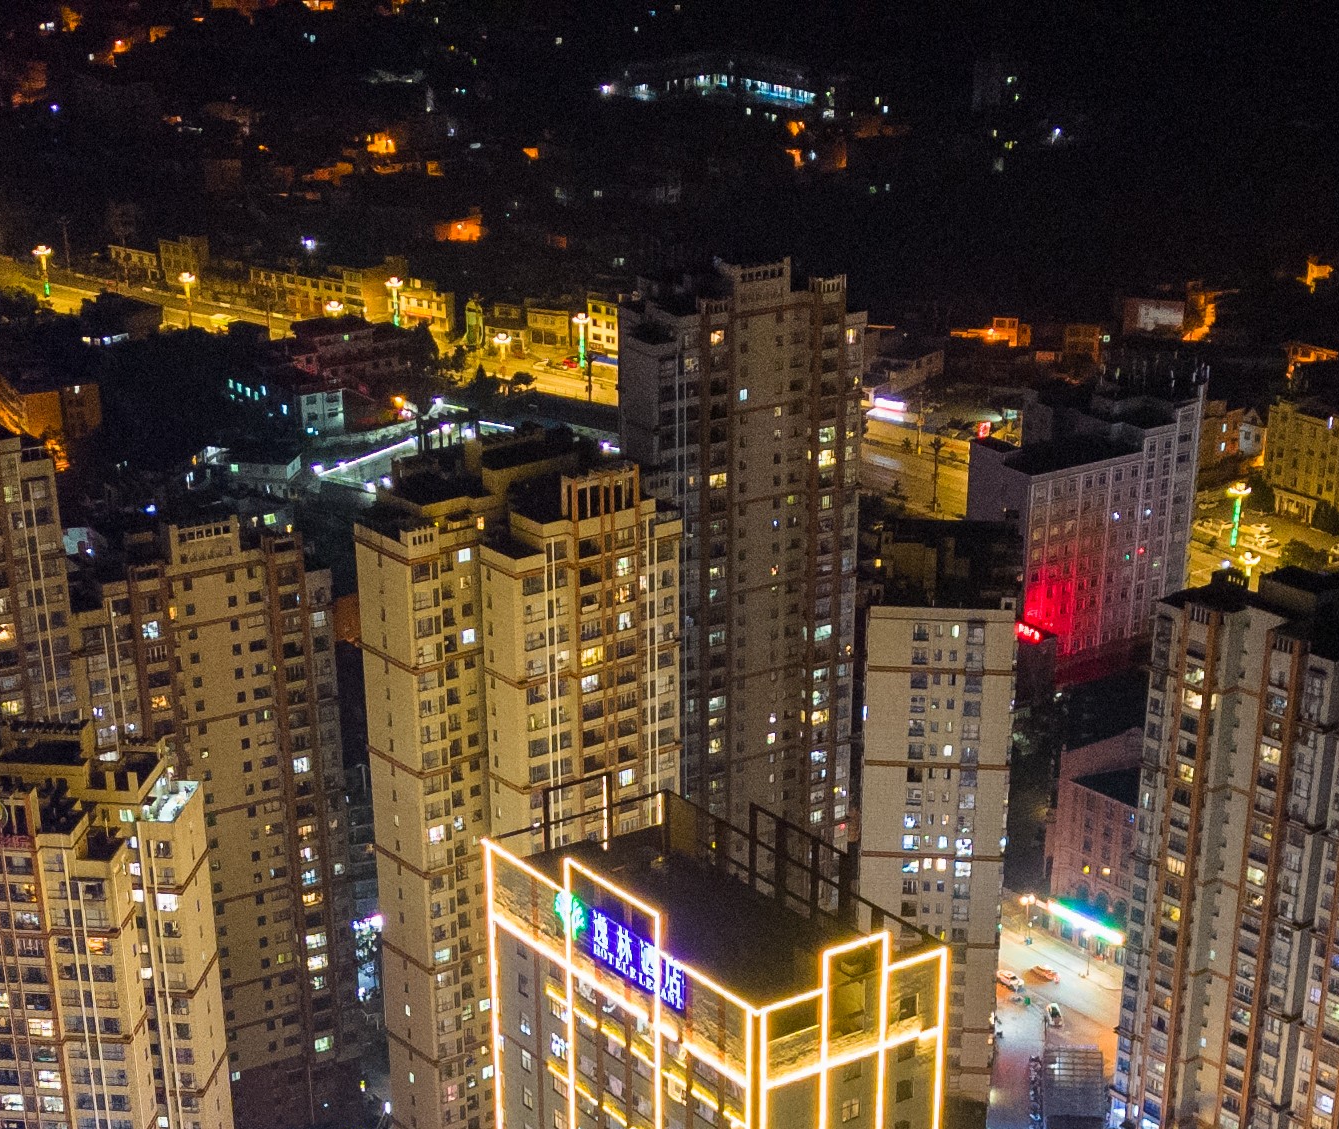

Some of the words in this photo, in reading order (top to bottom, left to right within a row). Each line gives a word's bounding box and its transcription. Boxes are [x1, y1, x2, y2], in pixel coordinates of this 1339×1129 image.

[593, 909, 683, 998] 逸林酒店
[593, 943, 629, 976] HOTEL
[629, 966, 684, 1010] ELEANT
